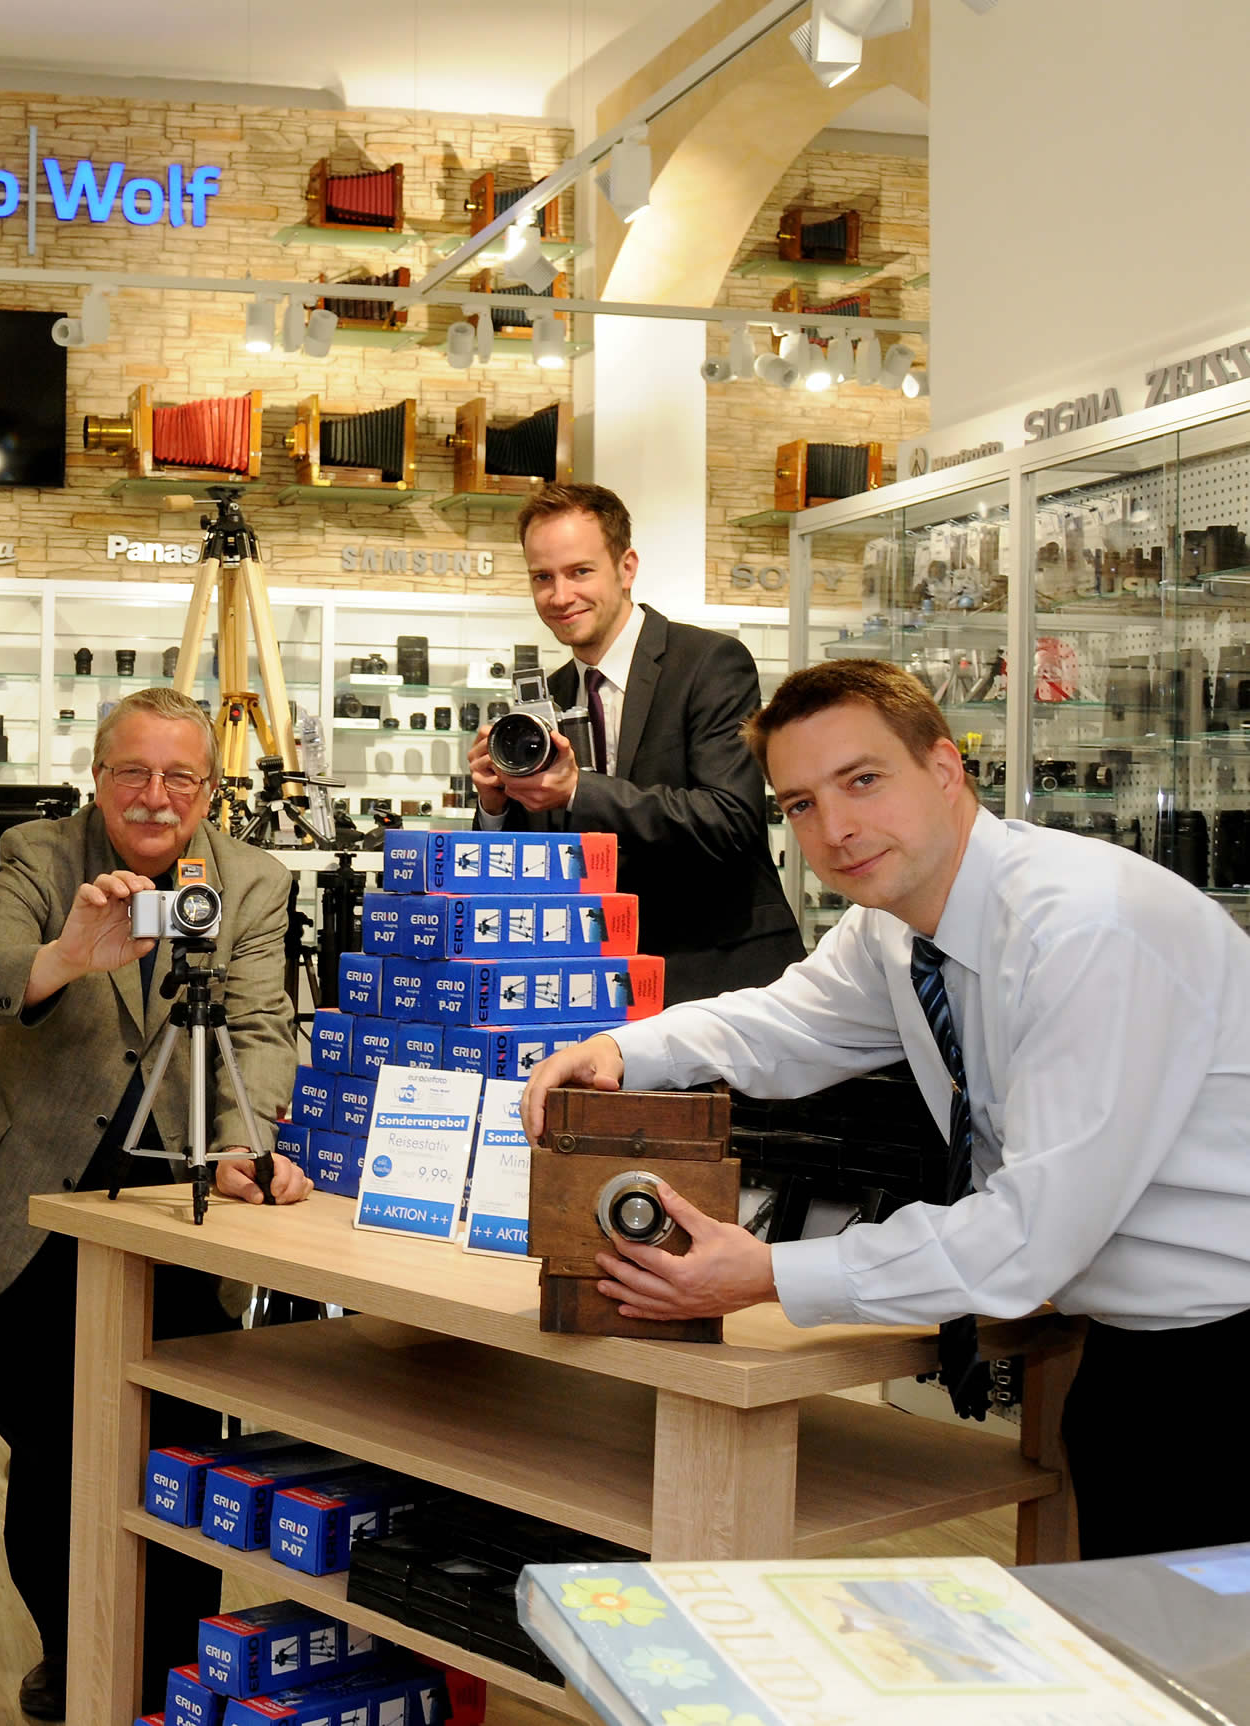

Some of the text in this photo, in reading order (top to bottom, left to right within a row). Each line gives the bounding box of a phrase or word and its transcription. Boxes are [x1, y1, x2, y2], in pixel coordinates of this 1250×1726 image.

[43, 158, 222, 228] Wolf
[1024, 387, 1123, 446] SIGMA
[342, 545, 494, 575] SAMSUNG
[732, 563, 847, 592] SOY
[390, 849, 418, 860] ERNO
[434, 834, 445, 888] ERNO
[393, 869, 414, 880] P-07
[371, 911, 399, 923] ERNO
[410, 914, 439, 926] ERNO
[454, 900, 465, 955] ERNO
[374, 931, 396, 943] P-07
[413, 935, 435, 947] P-07
[346, 970, 373, 983] ERNO
[393, 976, 421, 989] ERNO
[436, 980, 465, 992] ERNO
[349, 990, 369, 1002] P-07
[479, 967, 490, 1022] ERNO
[395, 997, 417, 1008] P-07
[439, 1001, 461, 1013] P-07
[319, 1030, 345, 1042] ERNO
[363, 1035, 390, 1048] ERNO
[406, 1040, 435, 1053] ERNO
[452, 1046, 481, 1059] ERNO
[322, 1049, 341, 1061] P-07
[365, 1055, 386, 1067] P-07
[496, 1035, 507, 1080] RNO
[301, 1085, 328, 1099] ERNO
[342, 1092, 368, 1106] ERNO
[303, 1105, 324, 1118] P-07
[345, 1112, 365, 1124] P-07
[378, 1115, 466, 1130] Sonderangebot
[388, 1132, 451, 1153] Reisestativ
[487, 1132, 530, 1144] Sonde
[277, 1140, 301, 1153] ERNO
[318, 1150, 343, 1164] ERNO
[320, 1170, 339, 1183] P-07
[383, 1206, 427, 1222] AKTION
[153, 1473, 179, 1491] ERNO
[155, 1495, 175, 1511] P-07
[213, 1494, 240, 1513] ERNO
[214, 1515, 235, 1533] P-07
[279, 1517, 308, 1537] ERNO
[281, 1540, 304, 1557] P-07
[205, 1645, 231, 1663] ERNO
[209, 1666, 229, 1682] P-07
[175, 1694, 202, 1716] ERNO
